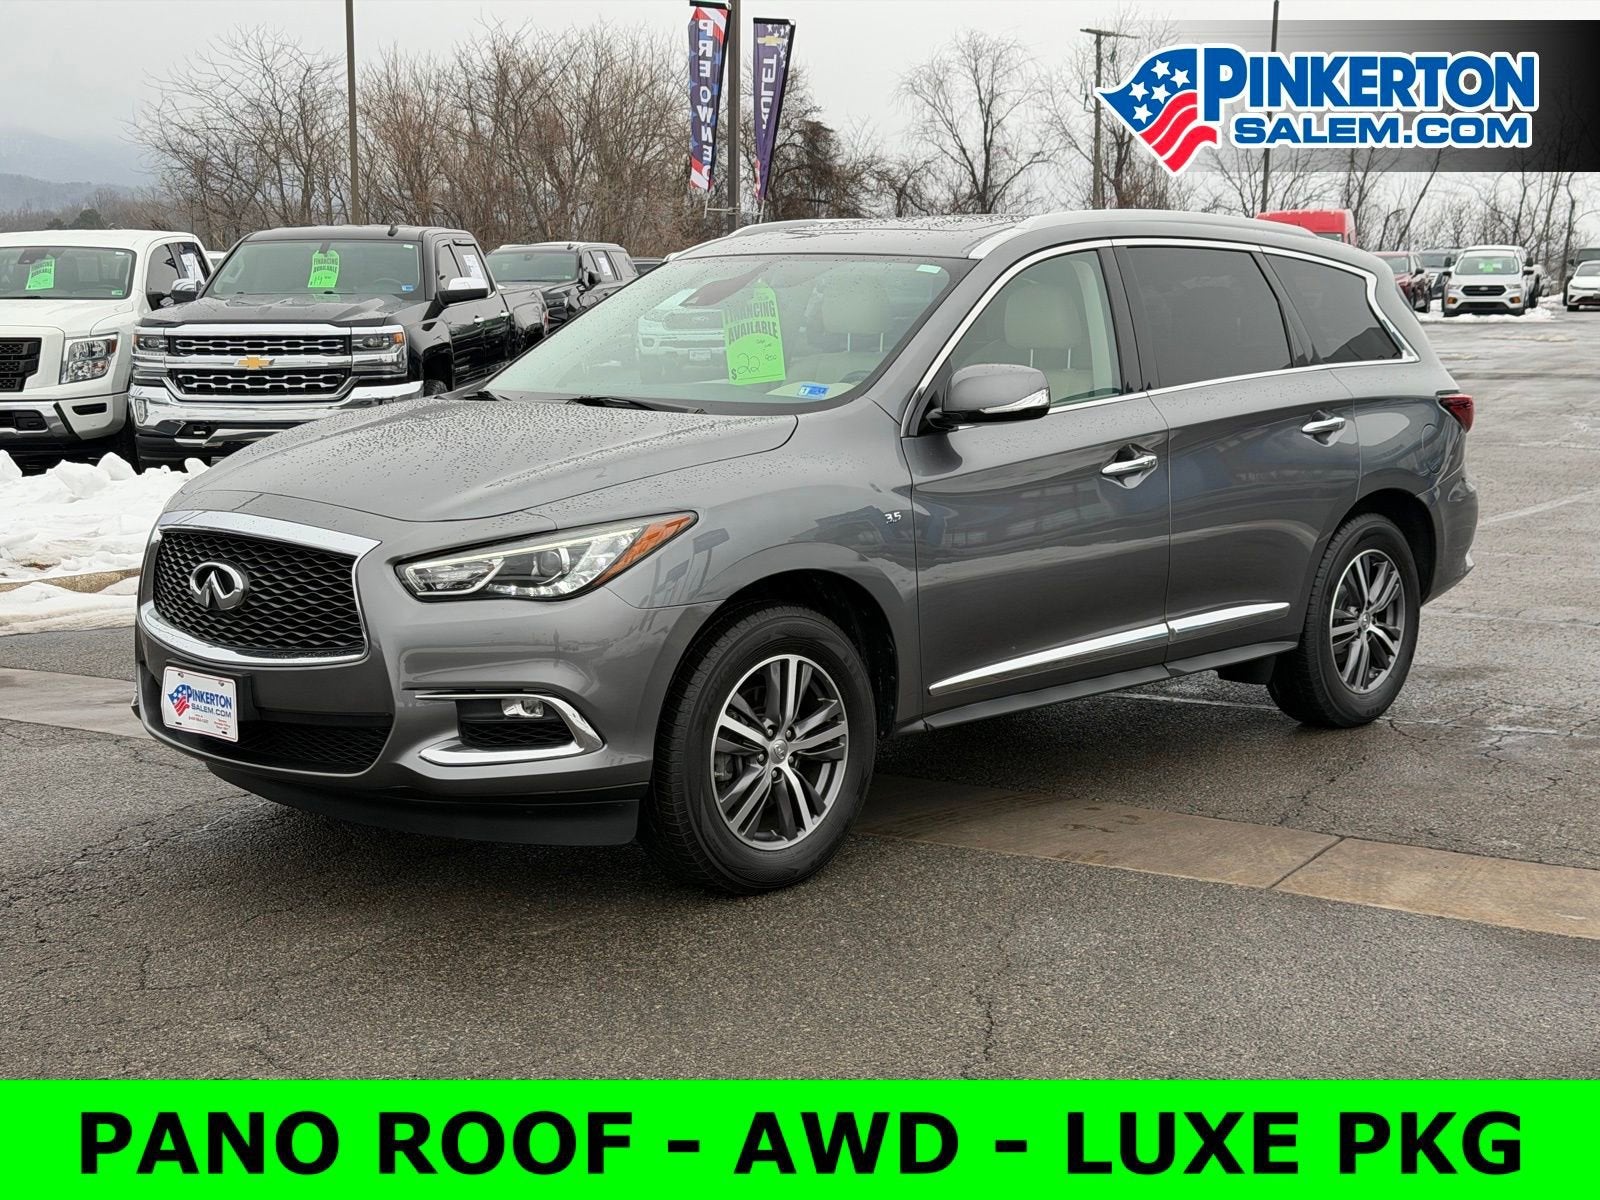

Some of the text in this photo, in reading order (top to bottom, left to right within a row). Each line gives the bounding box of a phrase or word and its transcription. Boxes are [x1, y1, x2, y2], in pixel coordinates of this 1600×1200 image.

[724, 300, 776, 324] FINANCING
[728, 320, 778, 345] AVAILABLE
[186, 685, 232, 710] PINKERTON
[191, 703, 231, 718] SALEM.COM
